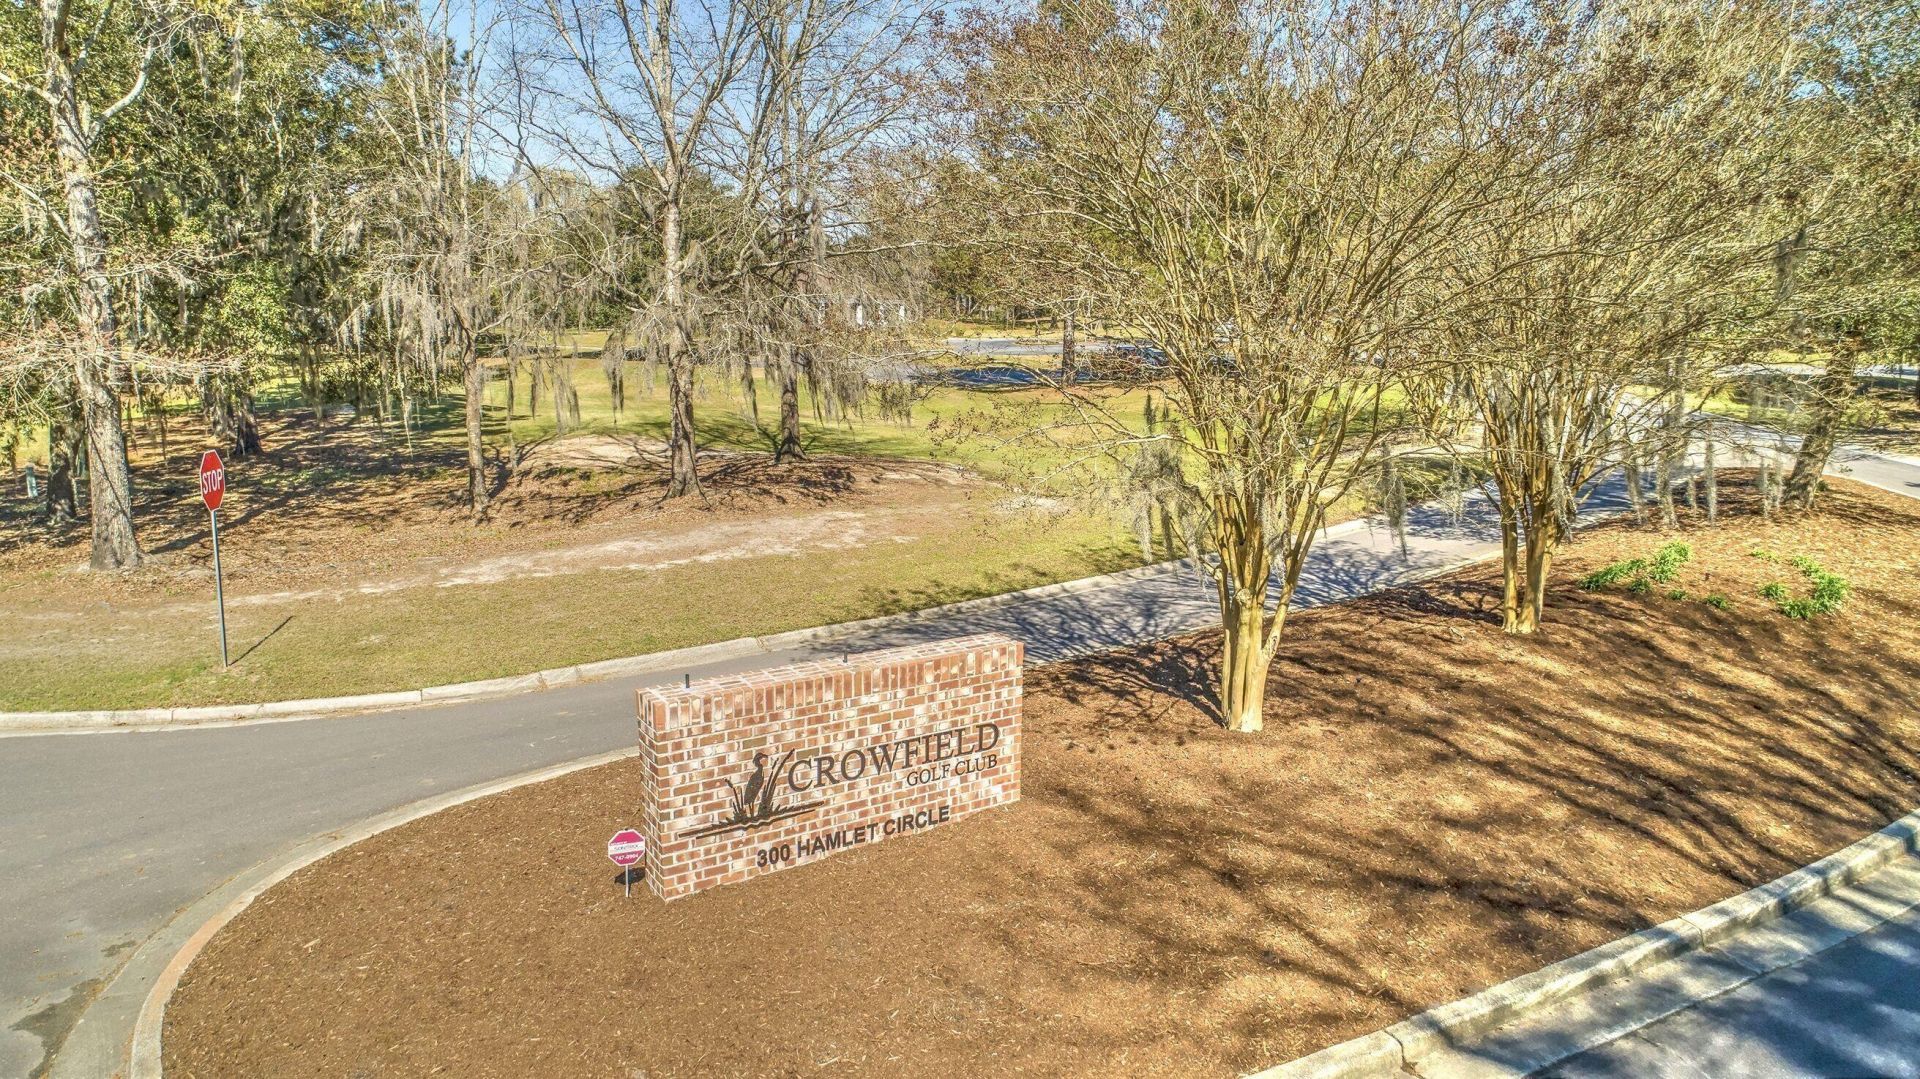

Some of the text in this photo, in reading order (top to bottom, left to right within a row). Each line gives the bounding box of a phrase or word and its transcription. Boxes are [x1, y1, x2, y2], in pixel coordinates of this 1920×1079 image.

[202, 468, 223, 495] STOP
[787, 723, 1000, 792] CROWFIELD
[906, 754, 998, 787] GOLF CLUB
[757, 805, 950, 868] 300 HAMLET CIRCLE
